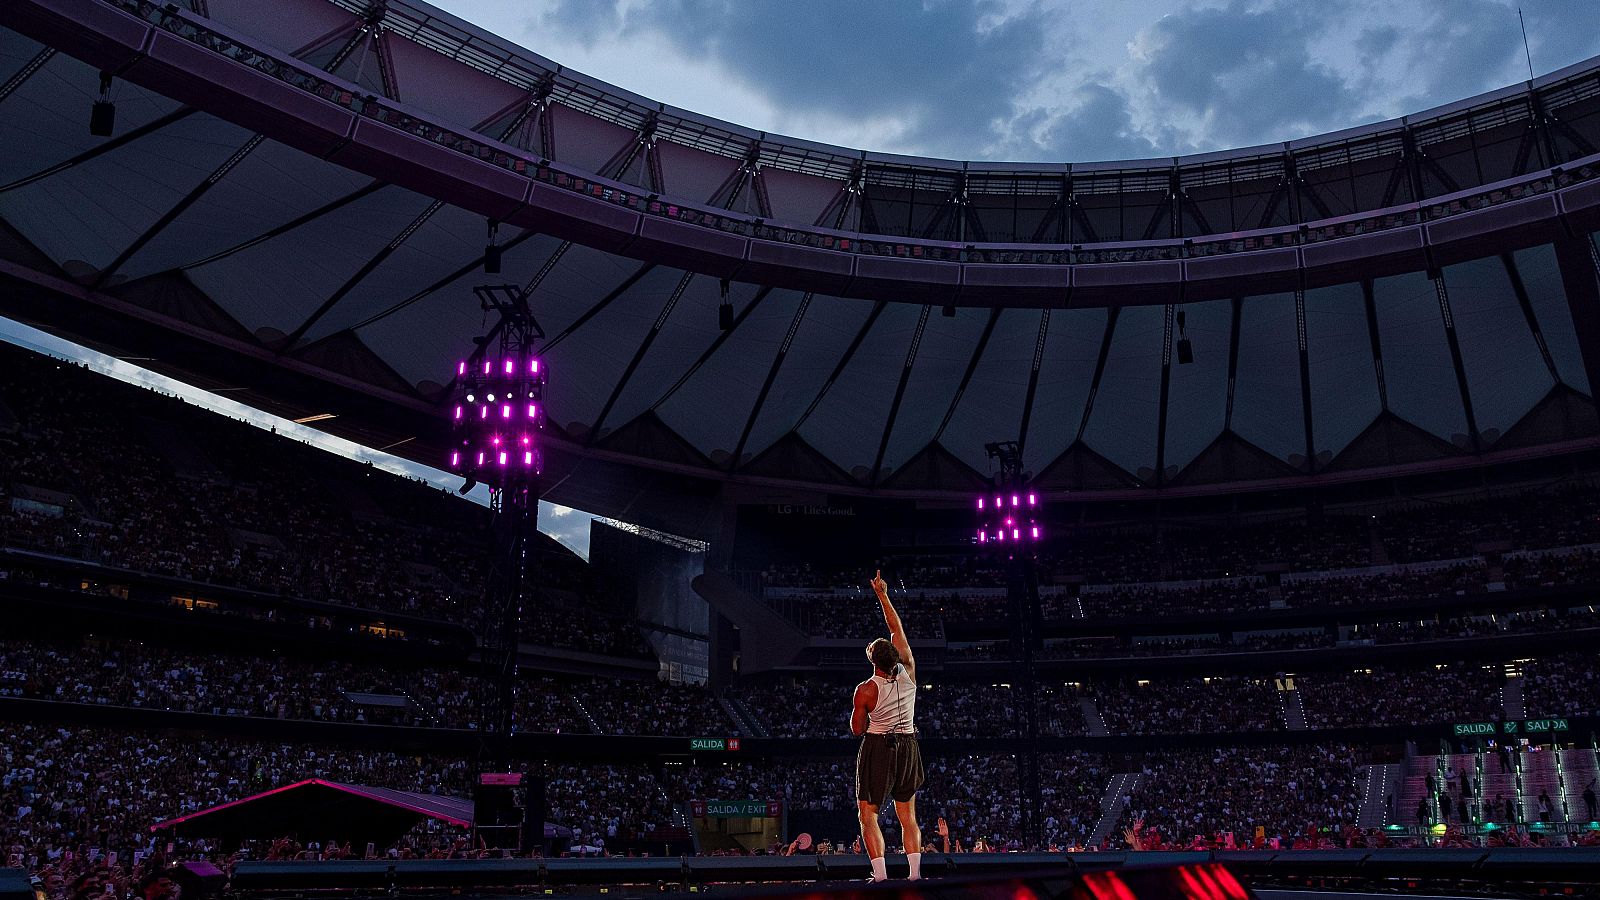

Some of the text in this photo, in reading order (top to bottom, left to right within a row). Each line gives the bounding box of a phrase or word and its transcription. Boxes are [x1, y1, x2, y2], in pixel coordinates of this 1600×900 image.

[777, 504, 792, 514] LG
[1456, 723, 1494, 734] SALIDA
[692, 740, 723, 748] SALIDA
[707, 805, 739, 814] SALIDA
[748, 805, 767, 813] EXIT
